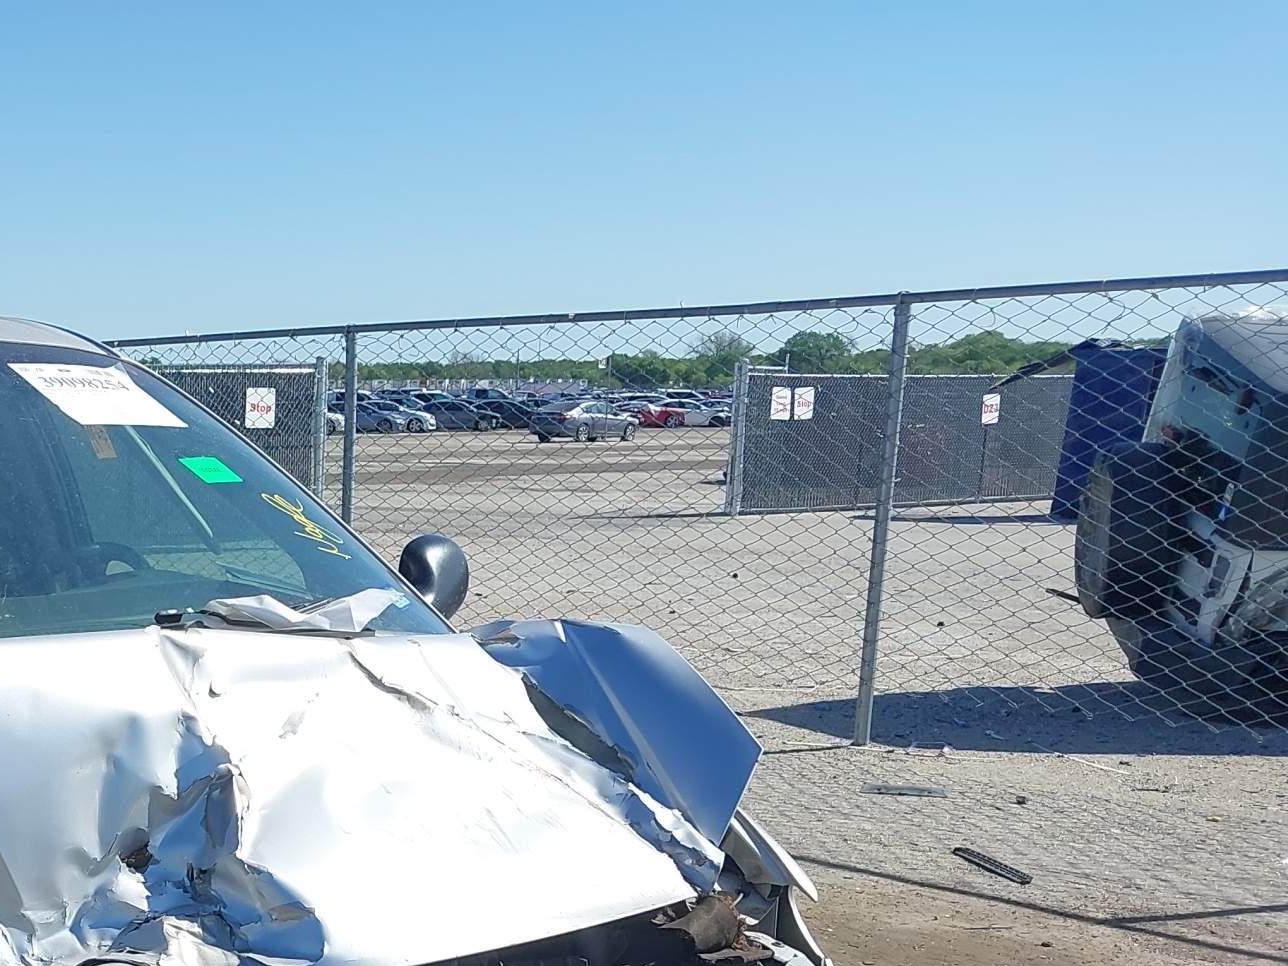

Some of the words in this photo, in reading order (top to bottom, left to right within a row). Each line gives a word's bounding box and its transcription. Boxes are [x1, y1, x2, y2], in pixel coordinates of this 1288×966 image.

[37, 376, 131, 392] 39098254
[249, 401, 272, 415] Stop
[796, 400, 812, 409] Stop
